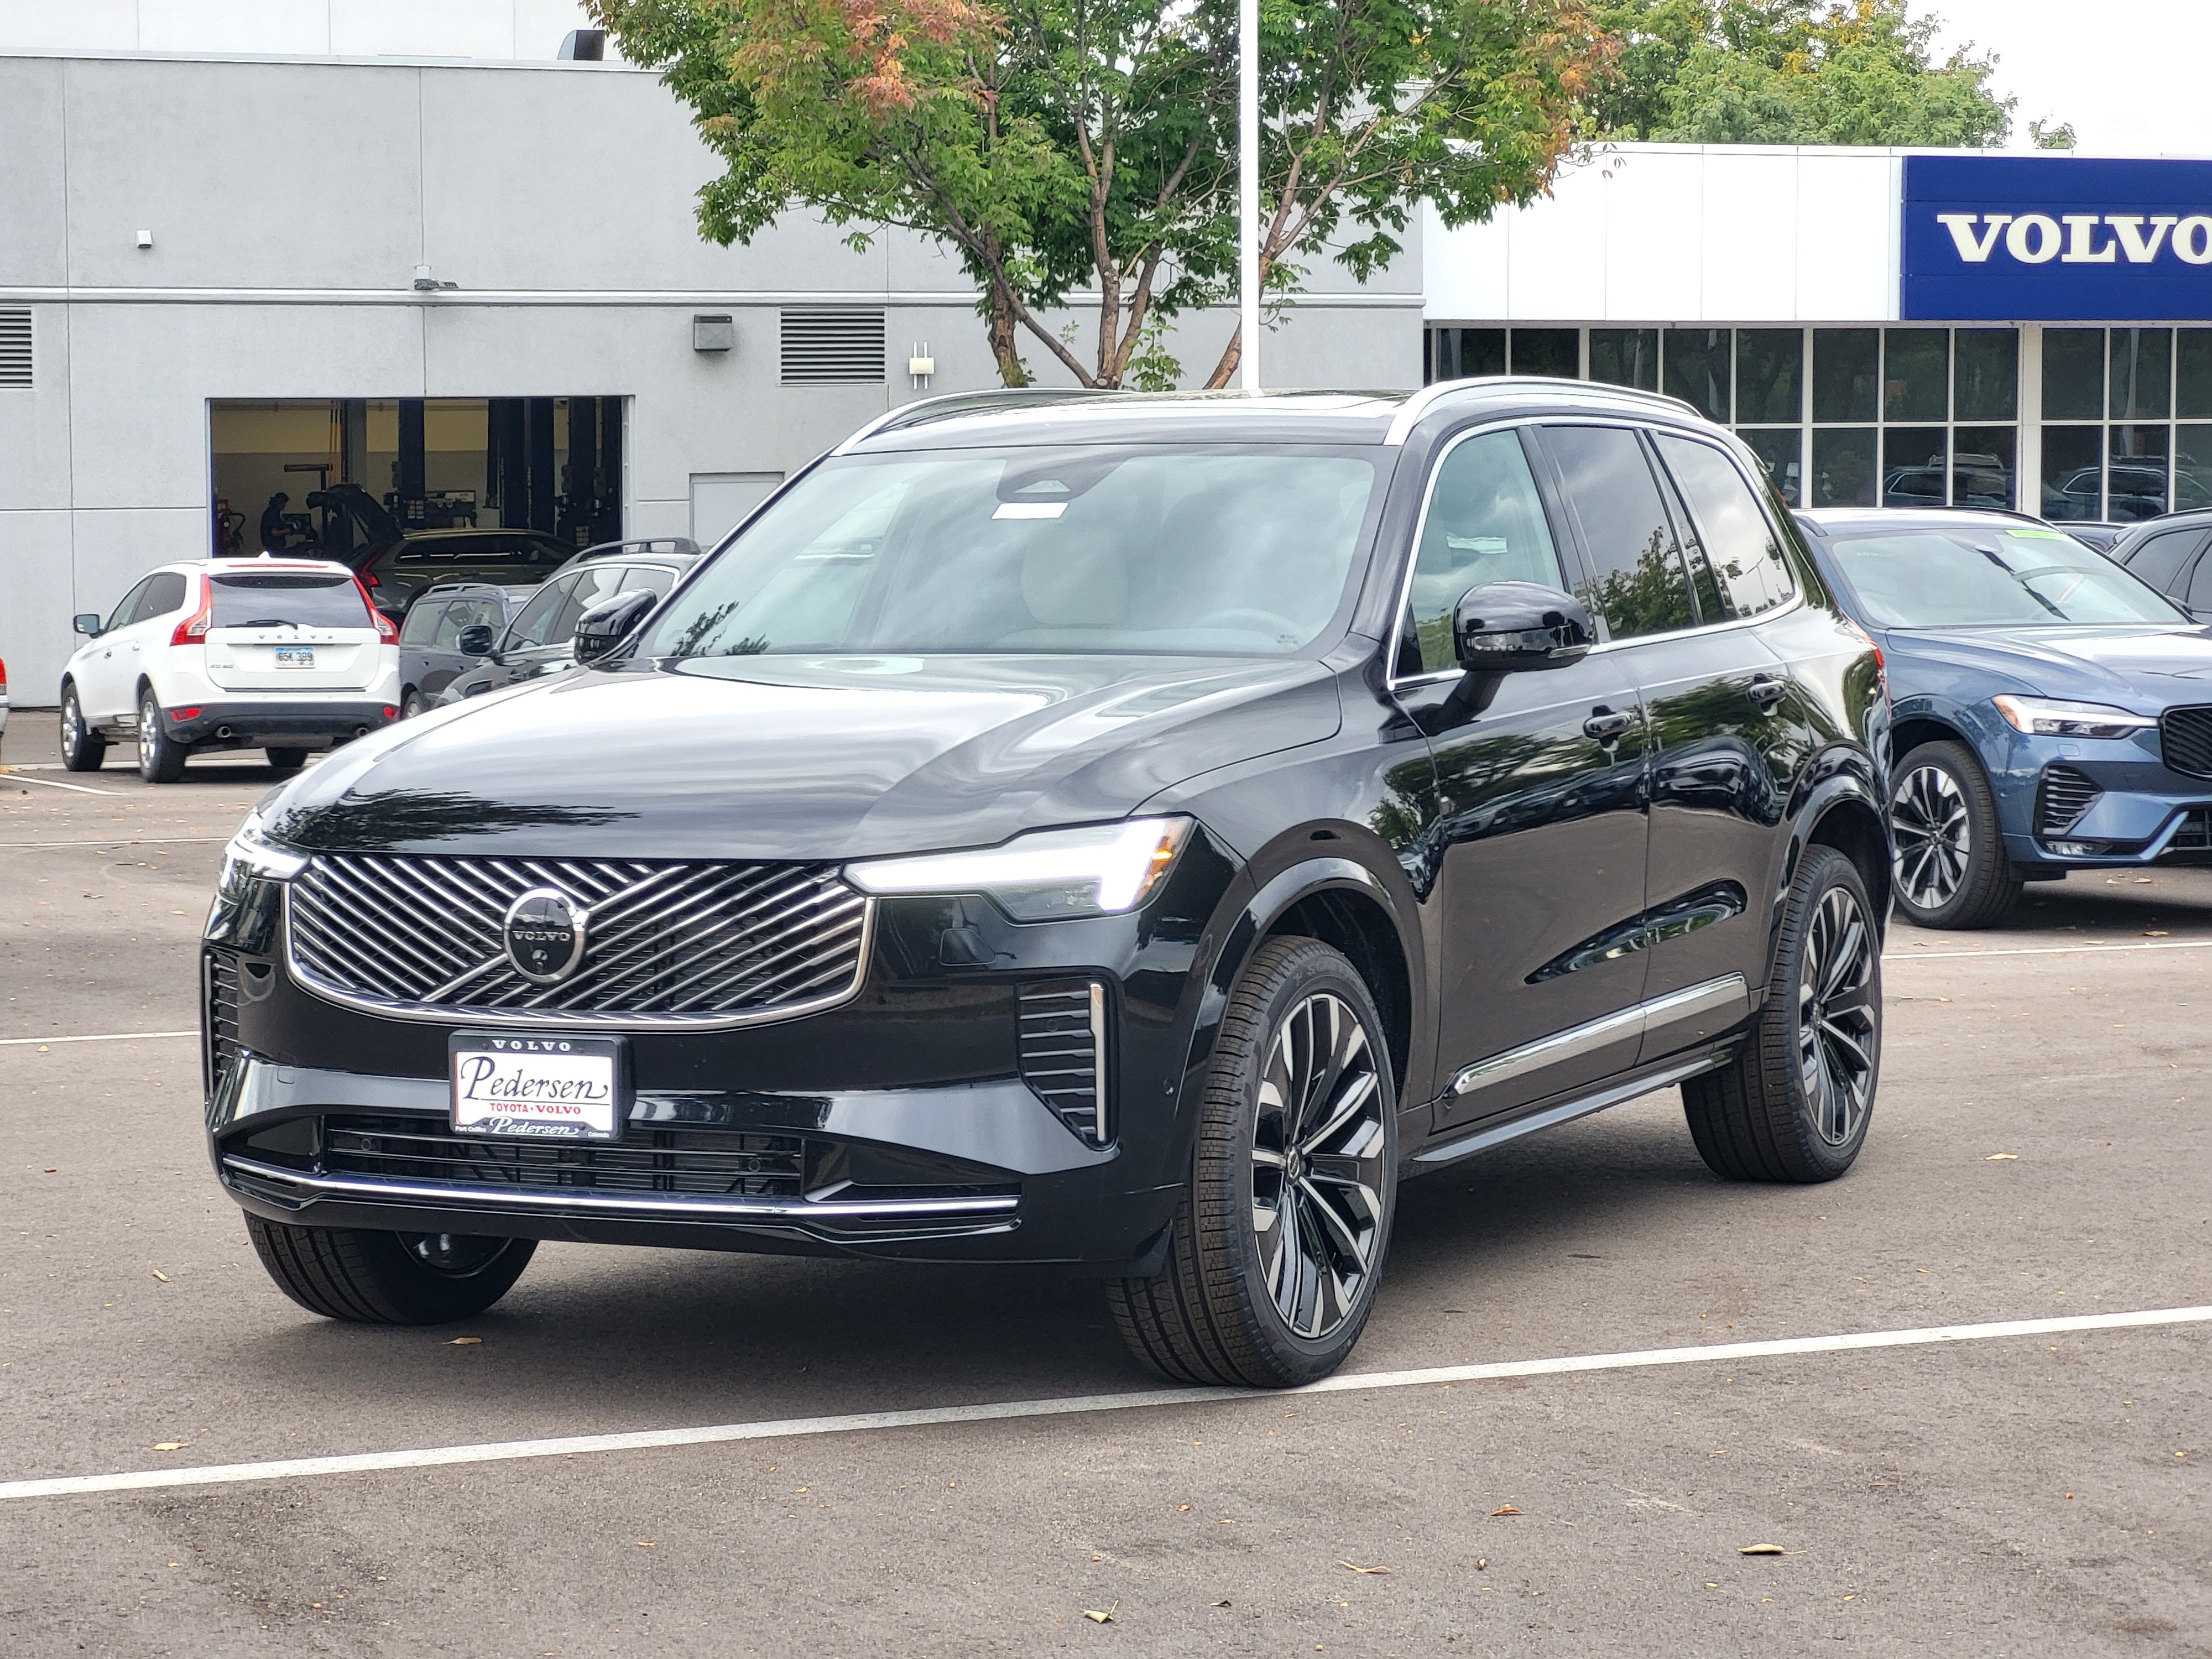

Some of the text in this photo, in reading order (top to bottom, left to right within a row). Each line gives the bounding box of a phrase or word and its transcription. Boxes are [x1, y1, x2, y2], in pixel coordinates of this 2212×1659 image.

[1937, 214, 2212, 264] VOLVO
[512, 931, 571, 941] VOLVO
[492, 1040, 571, 1052] VOLVO
[461, 1056, 608, 1099] Pedersen
[489, 1103, 581, 1114] TOYOTA VOLVO
[489, 1117, 580, 1136] Pedersen
